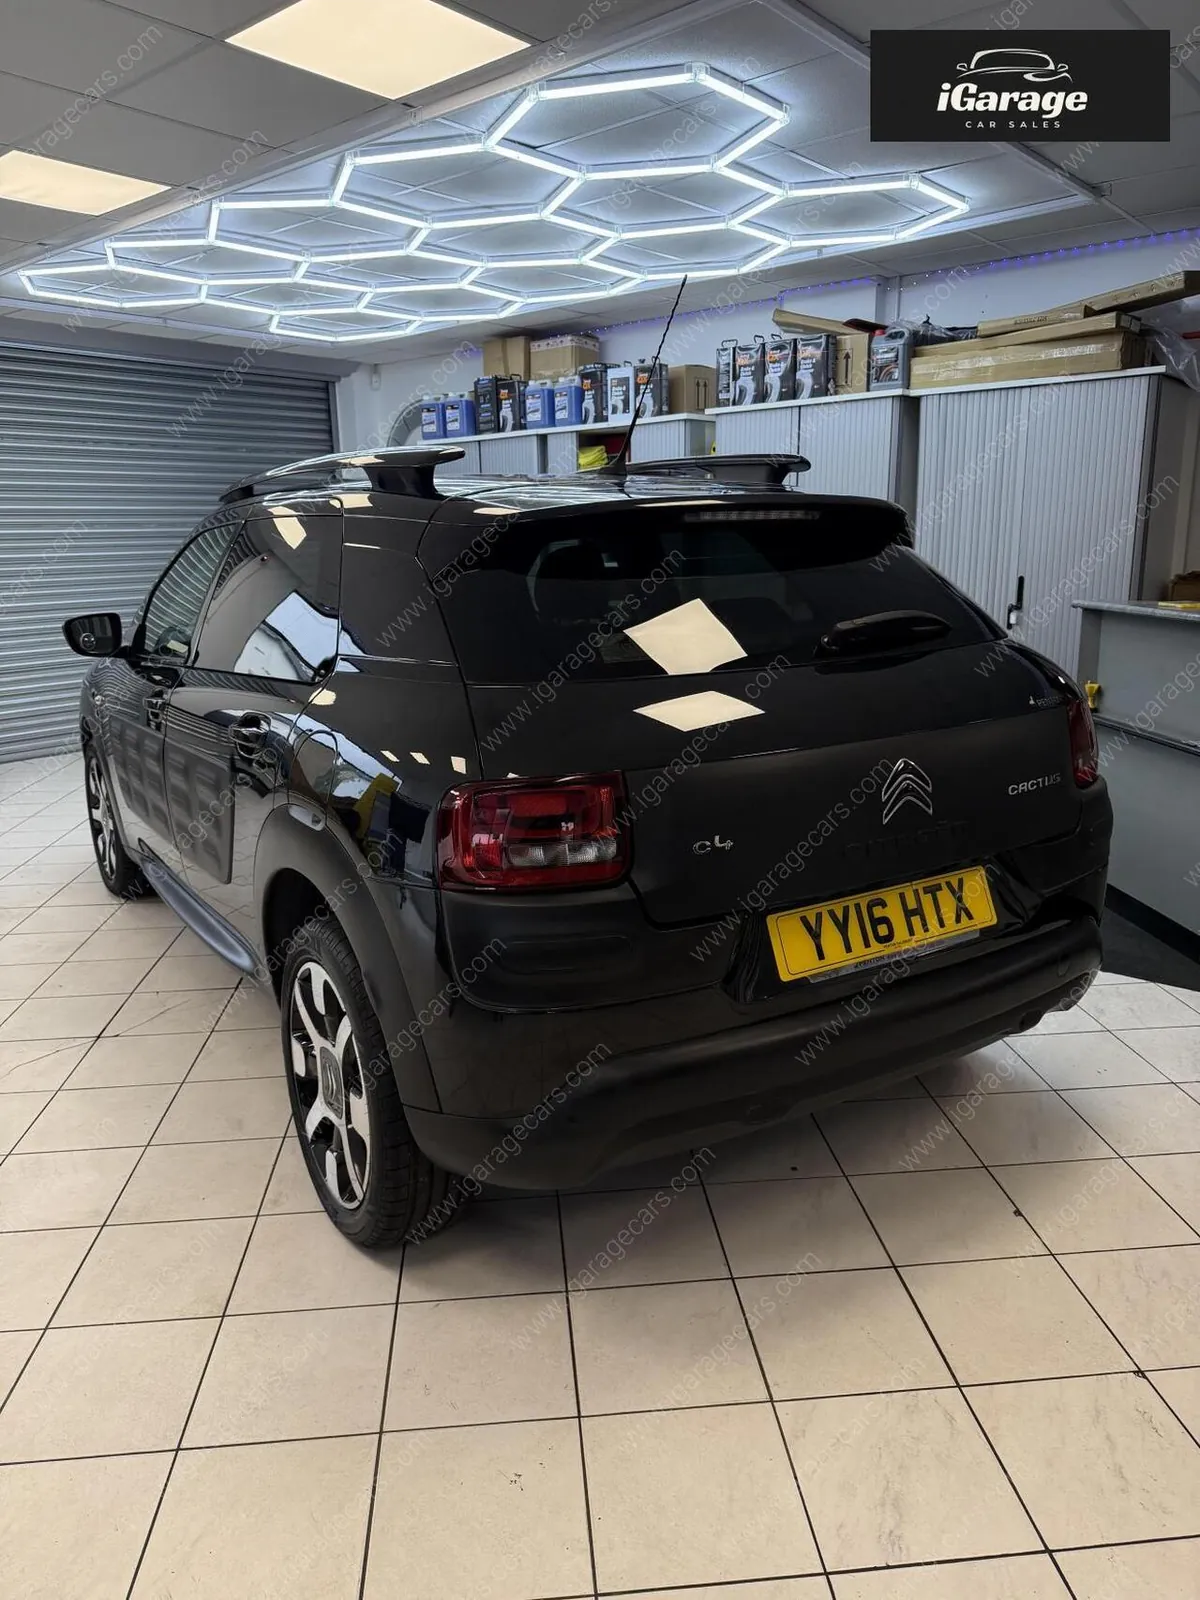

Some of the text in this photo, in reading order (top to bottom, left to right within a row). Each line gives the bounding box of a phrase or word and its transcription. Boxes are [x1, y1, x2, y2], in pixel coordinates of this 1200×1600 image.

[1008, 773, 1061, 795] CACTUS
[692, 834, 734, 855] C4
[800, 877, 974, 961] YY16 HTX
